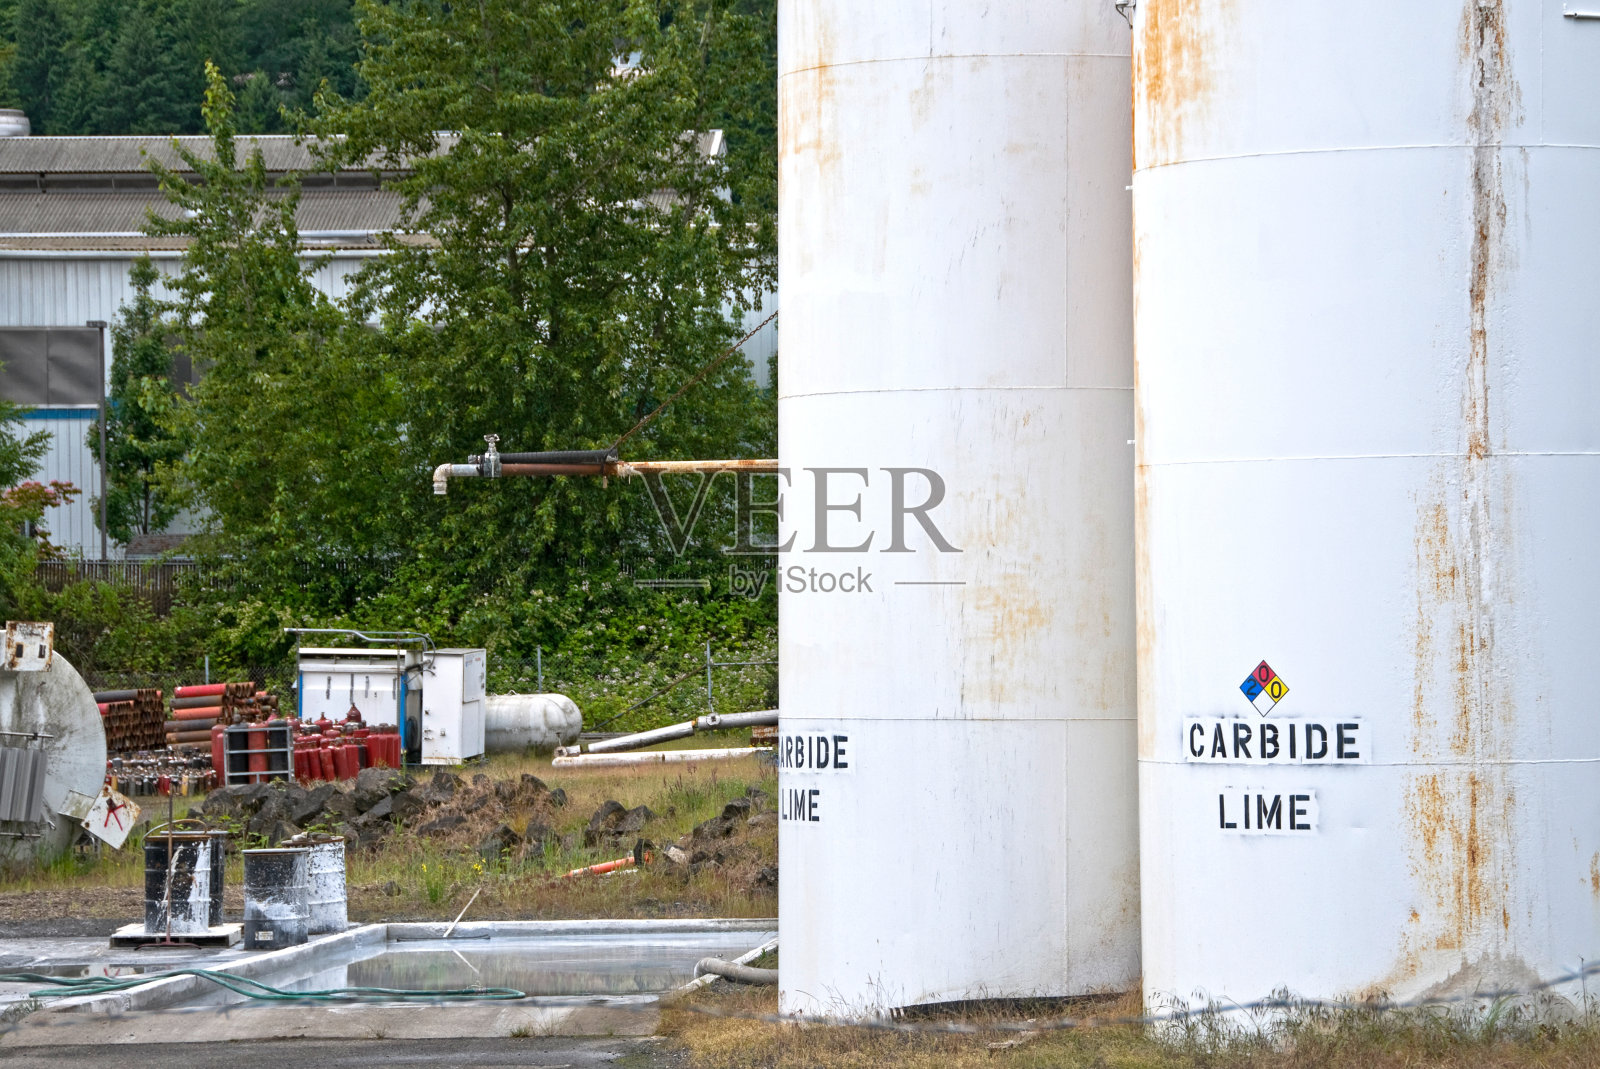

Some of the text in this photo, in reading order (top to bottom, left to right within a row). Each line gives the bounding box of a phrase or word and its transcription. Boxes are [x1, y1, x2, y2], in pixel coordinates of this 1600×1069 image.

[1246, 678, 1282, 699] 2 0
[1258, 665, 1270, 683] 0
[1189, 722, 1360, 759] CARBIDE
[782, 787, 820, 822] LIME
[1219, 794, 1311, 830] LIME
